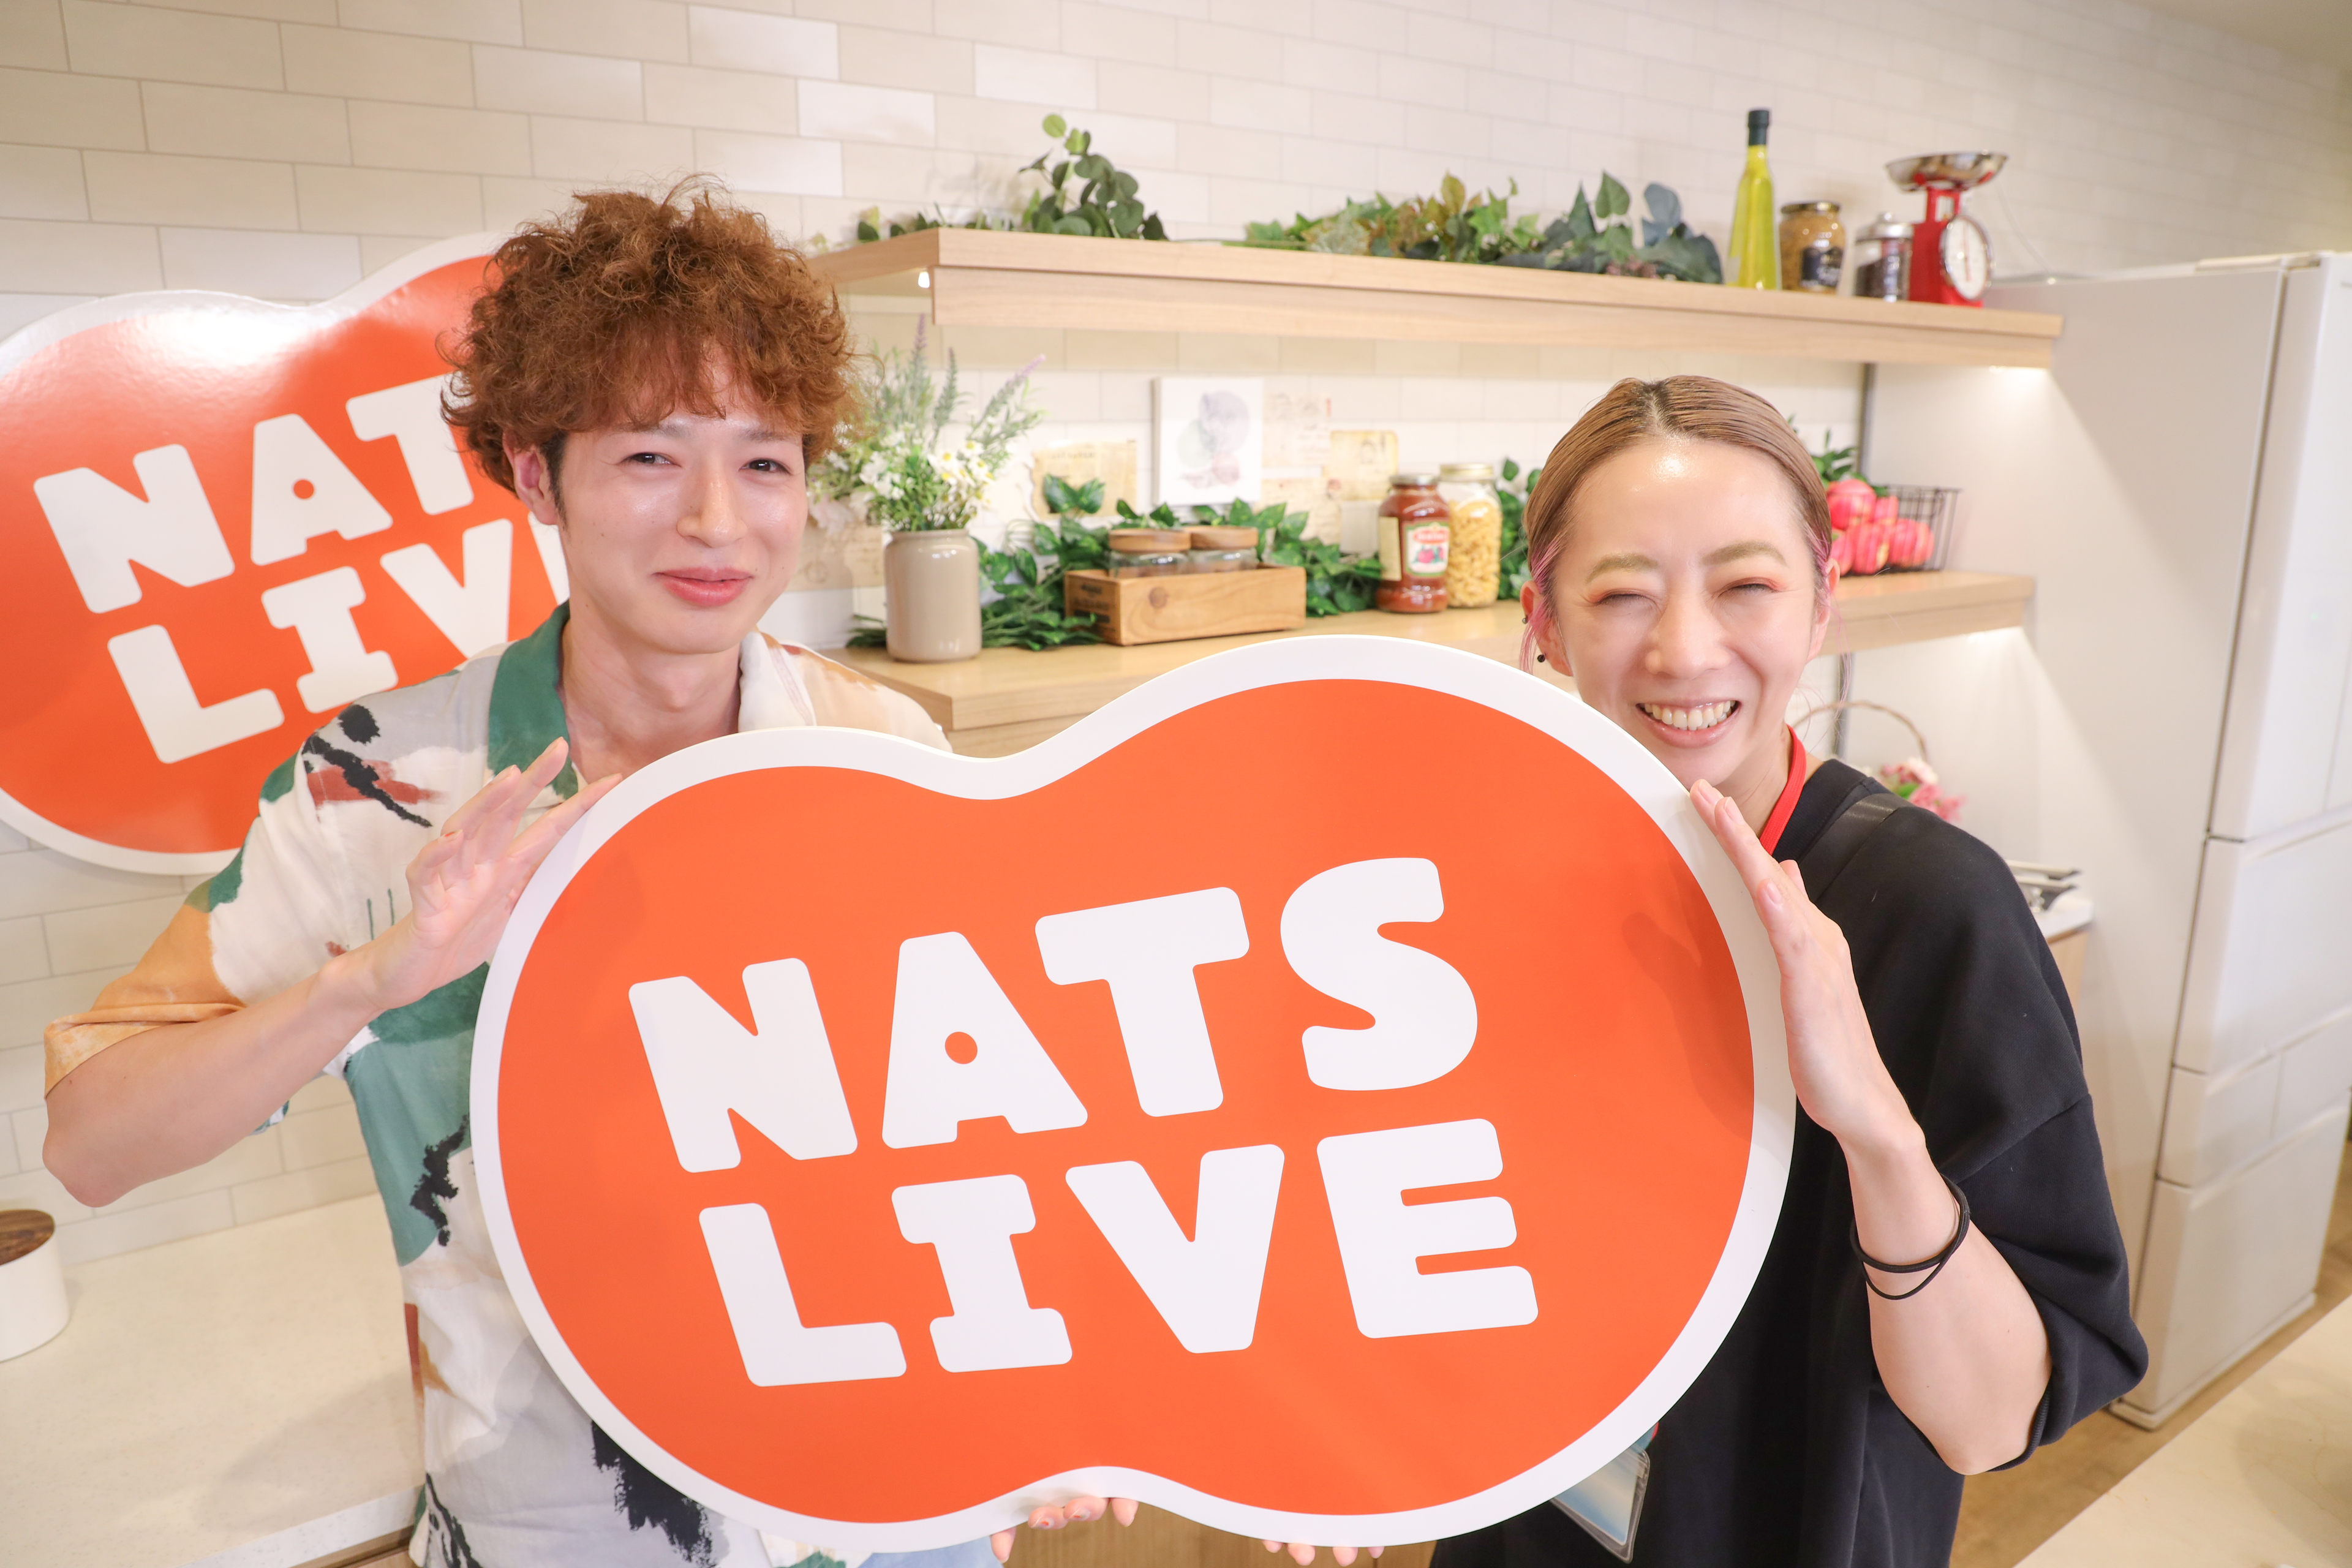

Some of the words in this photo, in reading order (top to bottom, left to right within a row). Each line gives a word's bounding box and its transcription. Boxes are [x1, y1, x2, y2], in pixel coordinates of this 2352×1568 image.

[34, 372, 475, 613] NAT
[108, 513, 570, 763] LIV
[628, 858, 1477, 1172] NATS
[699, 1118, 1538, 1387] LIVE
